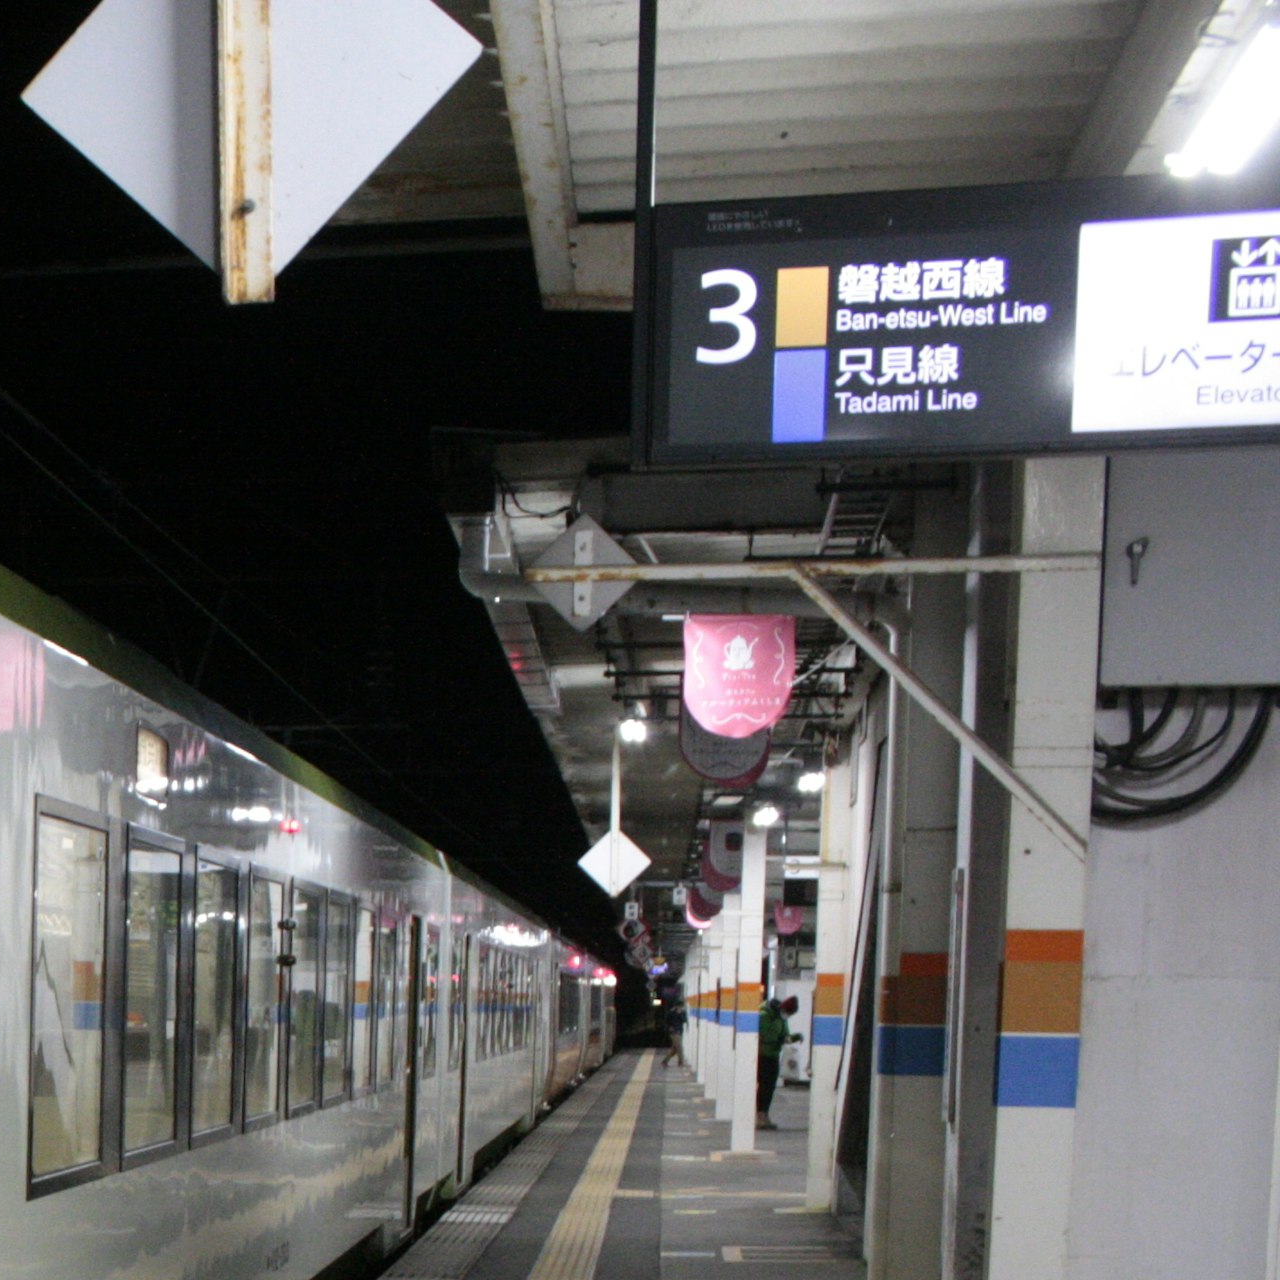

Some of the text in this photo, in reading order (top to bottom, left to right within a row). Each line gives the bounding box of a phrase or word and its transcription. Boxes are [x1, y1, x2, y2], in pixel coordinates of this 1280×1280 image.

[838, 256, 1008, 304] 磐越西線
[696, 267, 759, 365] 3
[835, 301, 1049, 332] Ban-etsu-West Line
[835, 343, 960, 387] 只見線
[834, 388, 979, 415] Tadami Line
